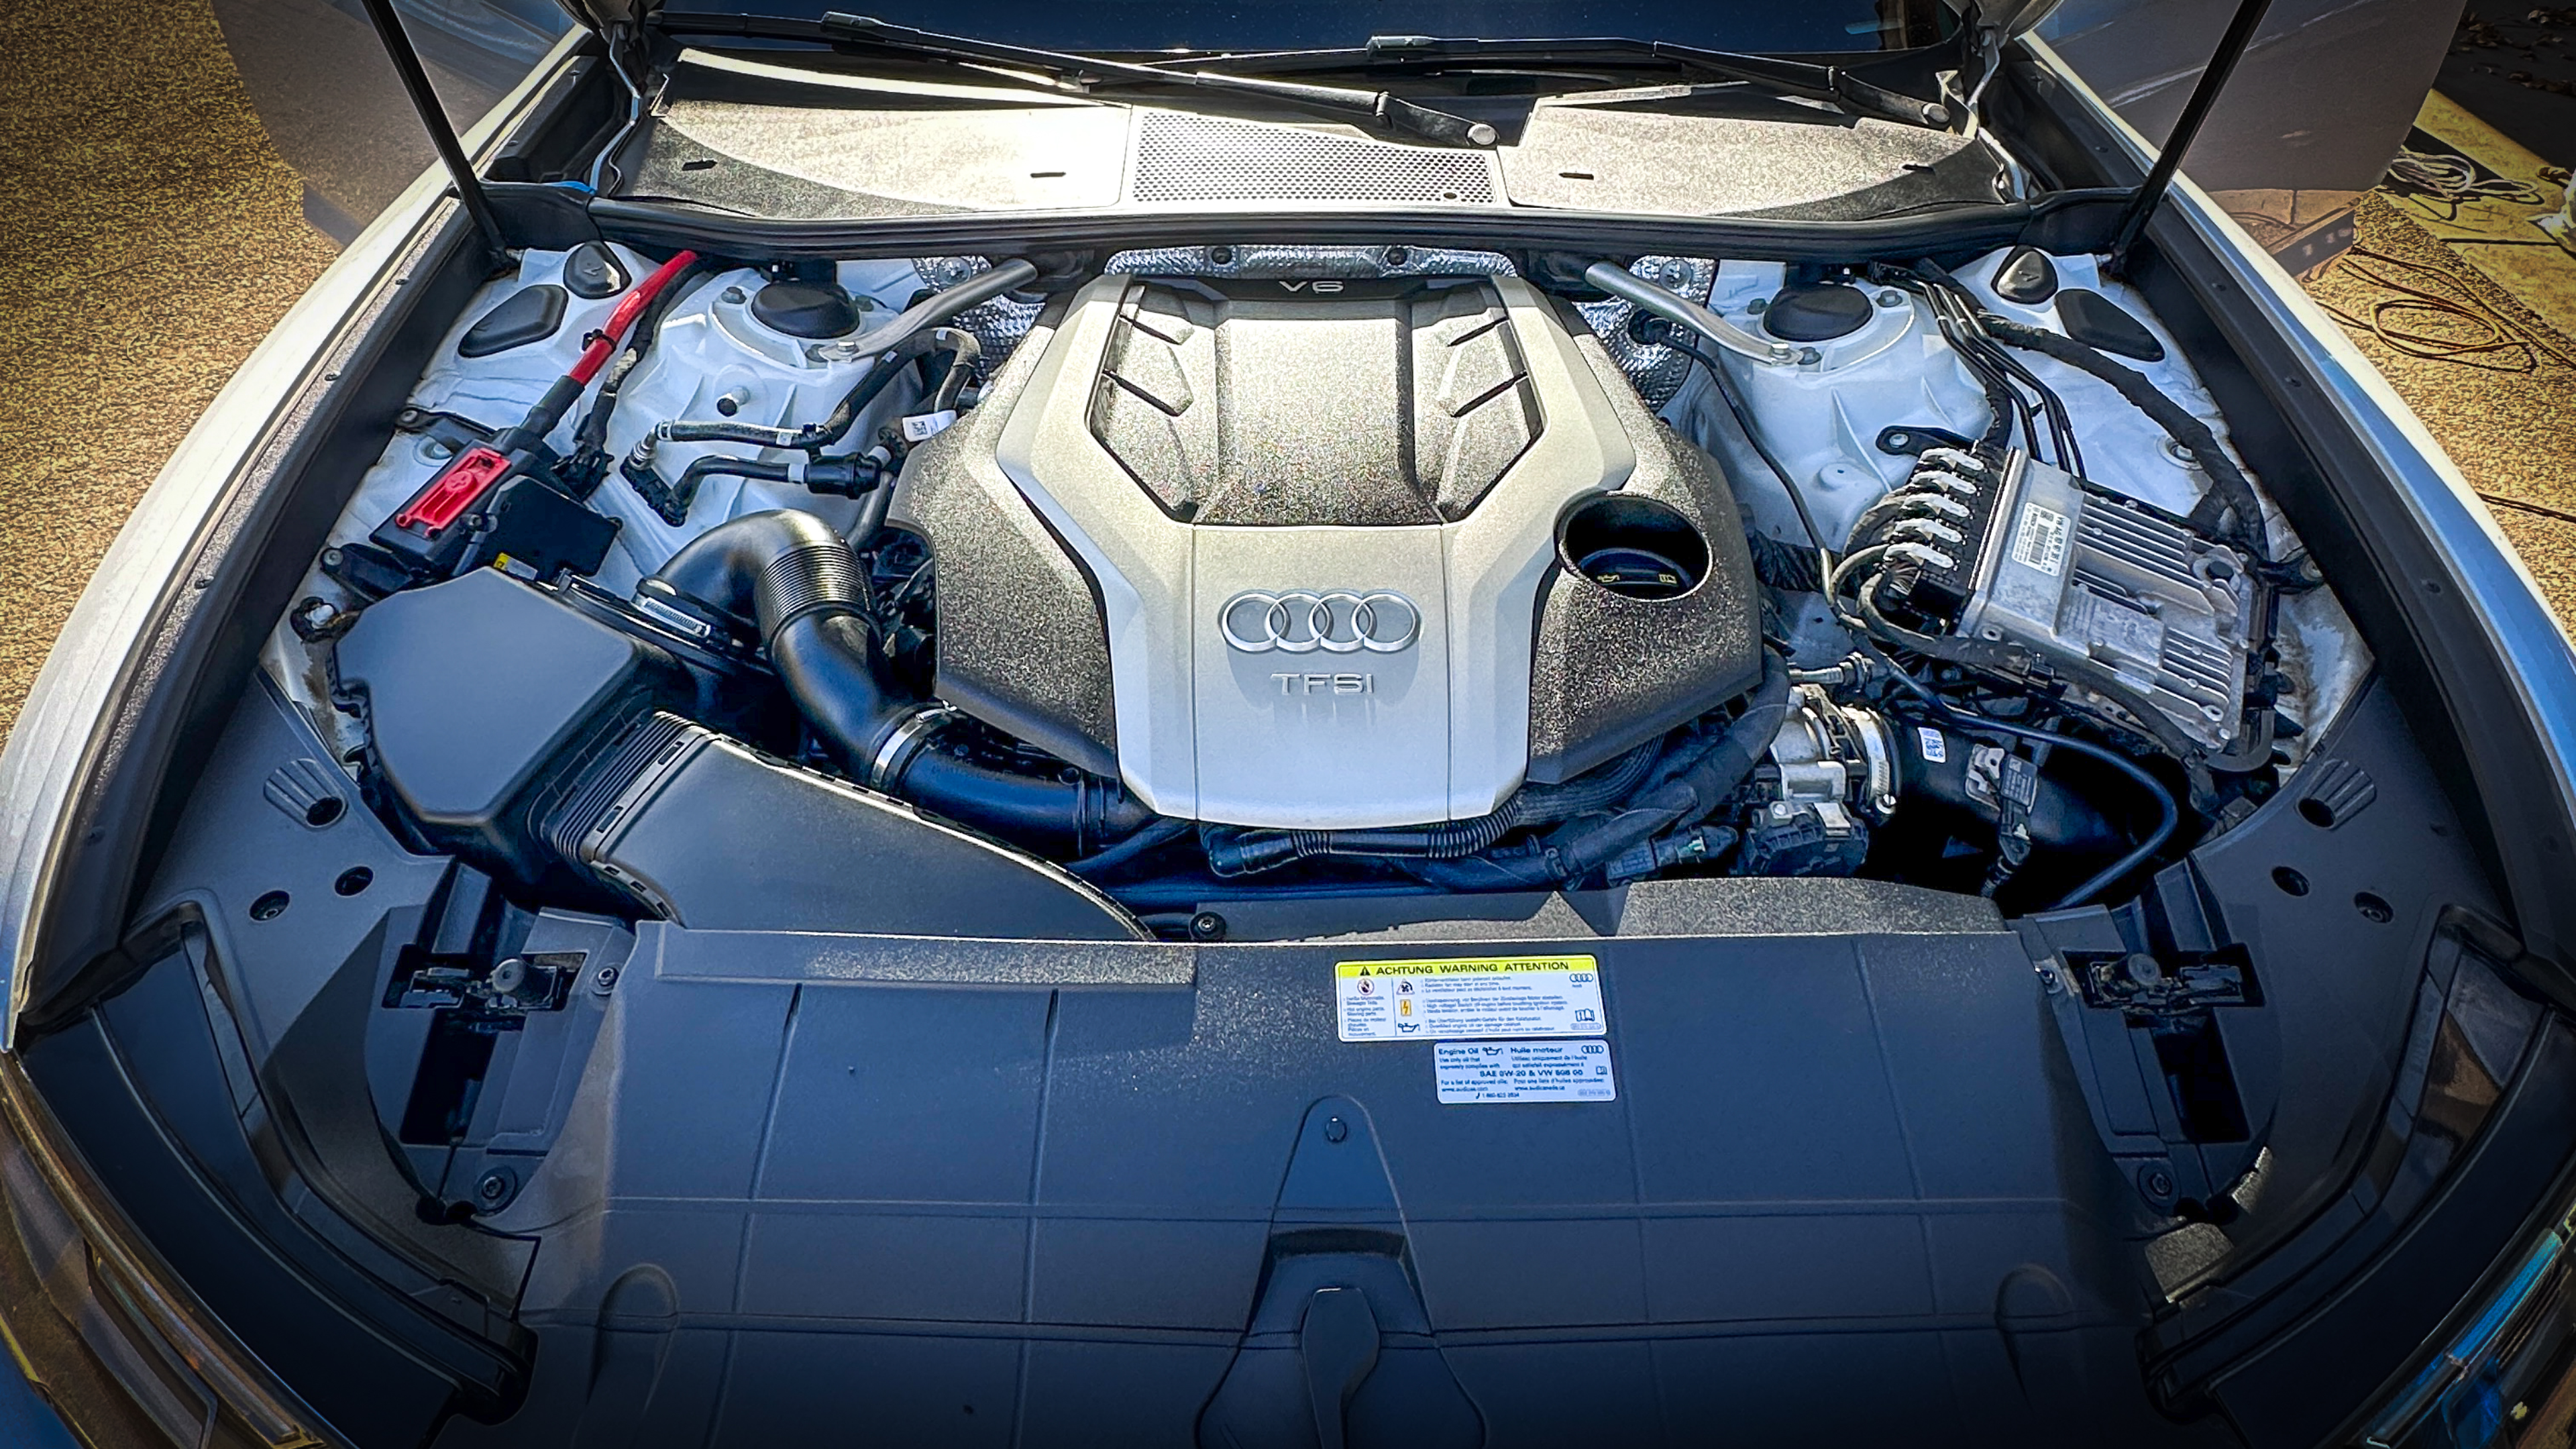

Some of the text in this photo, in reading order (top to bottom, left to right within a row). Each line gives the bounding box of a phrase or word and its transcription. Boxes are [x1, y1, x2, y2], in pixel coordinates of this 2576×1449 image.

[1279, 280, 1344, 293] V6
[1271, 673, 1374, 695] TFSI
[1376, 962, 1568, 975] ACHTUNG WARNING ATTENTION
